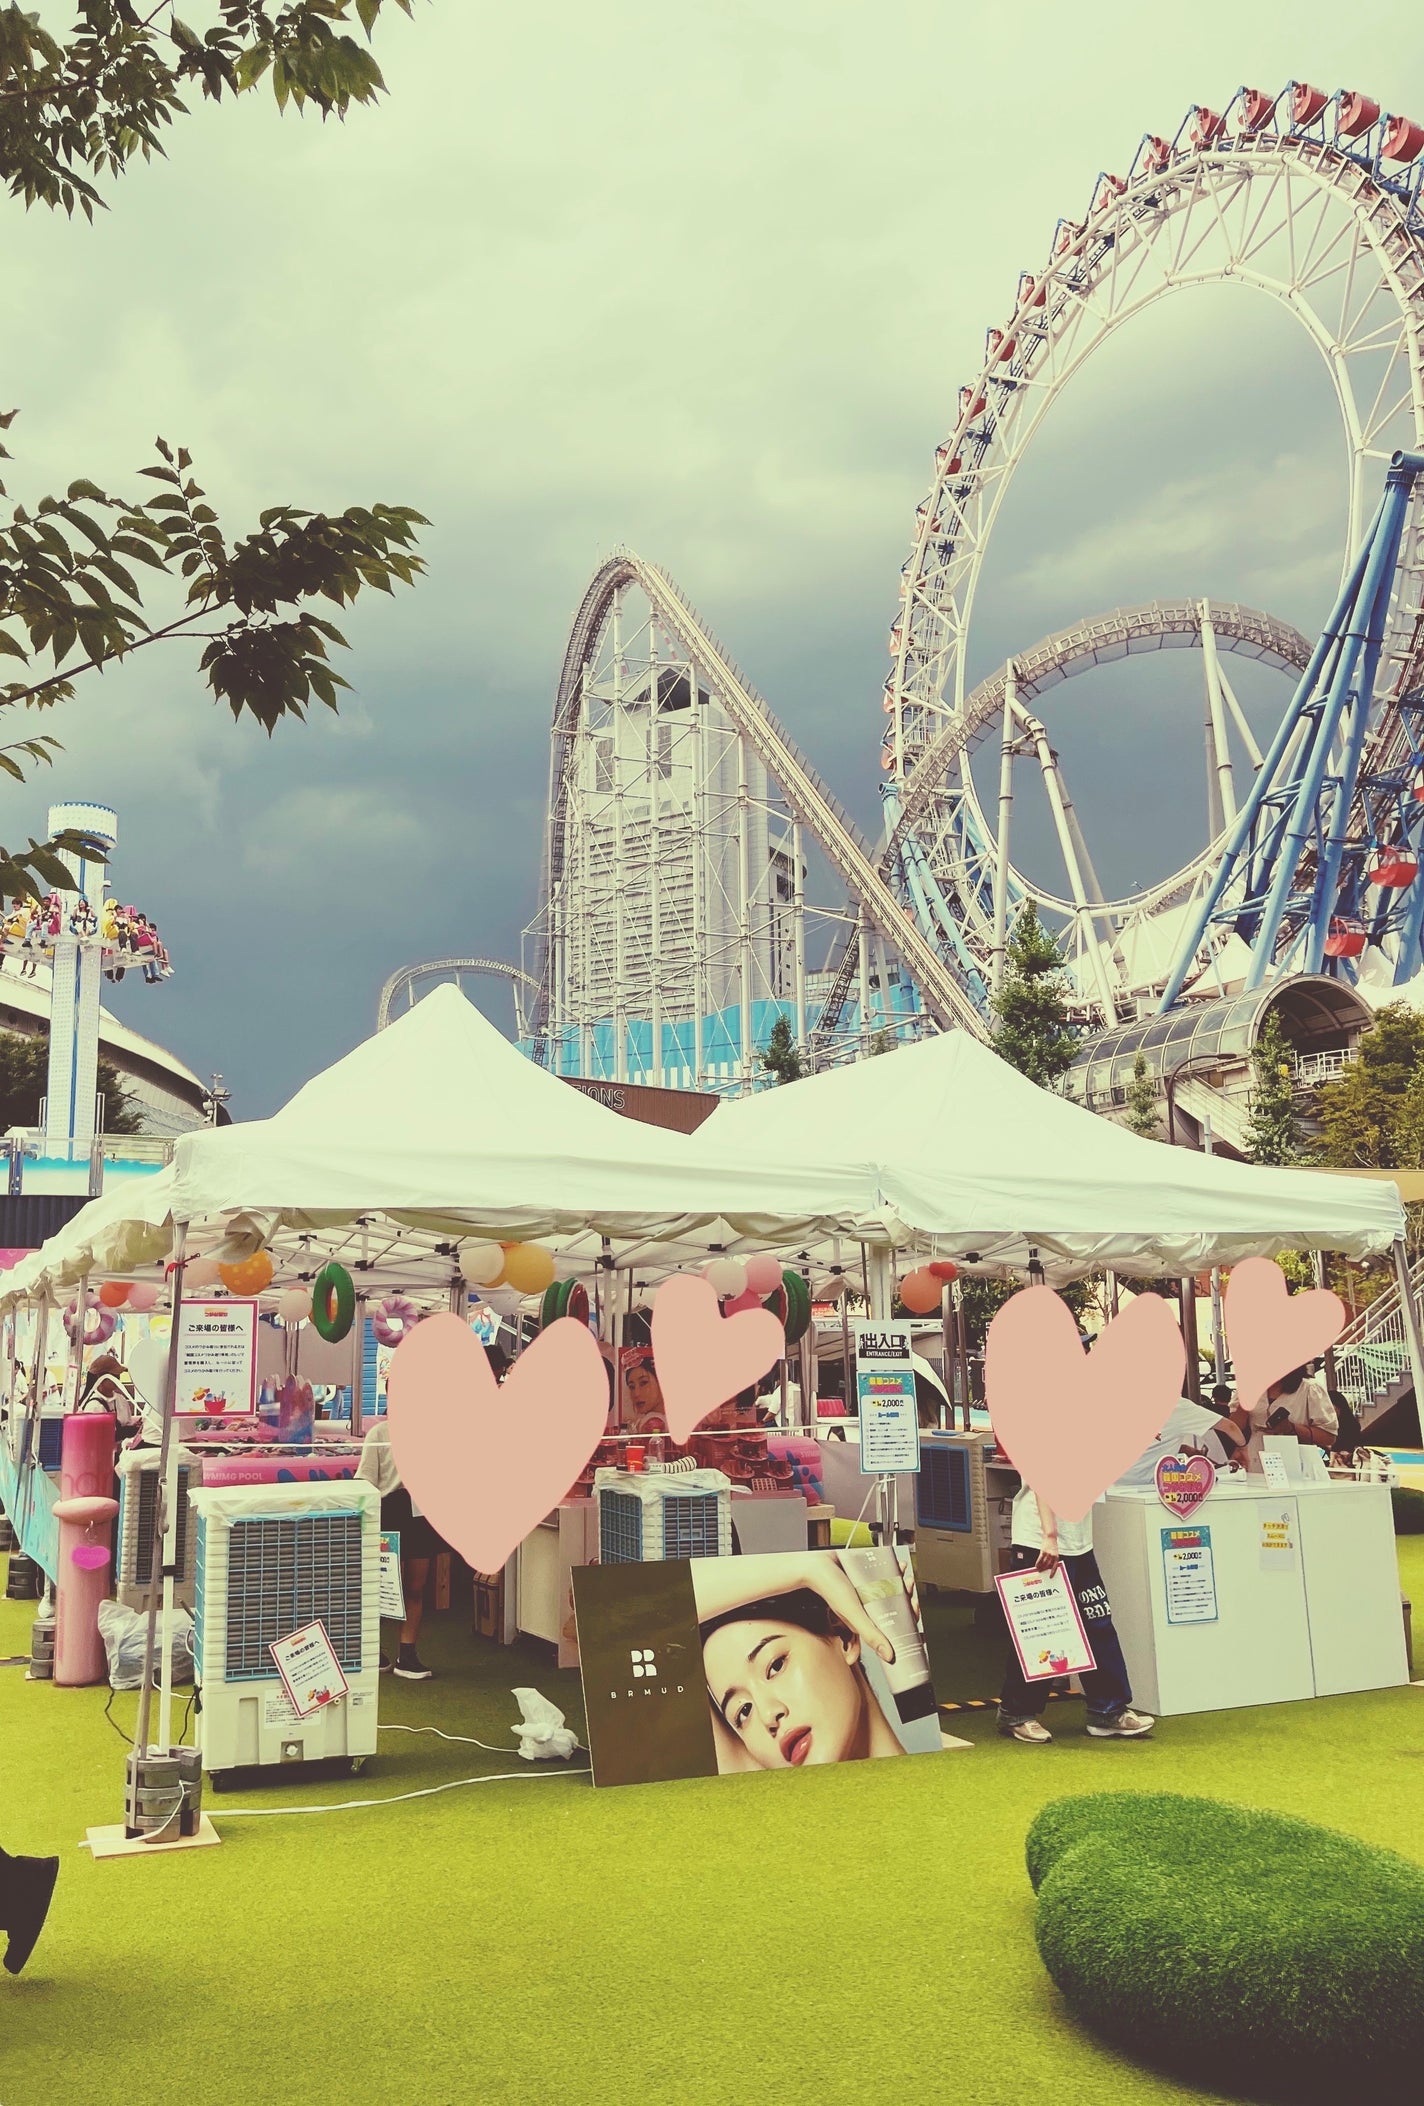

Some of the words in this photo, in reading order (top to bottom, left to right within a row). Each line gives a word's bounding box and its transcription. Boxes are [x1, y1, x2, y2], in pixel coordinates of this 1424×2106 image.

[571, 1084, 625, 1109] ONS
[188, 1324, 244, 1332] ご来場の皆様へ
[865, 1333, 903, 1349] 出入口
[239, 1472, 263, 1481] POOL
[1014, 1588, 1060, 1603] ご来場の皆様へ
[610, 1685, 684, 1699] BRMUD
